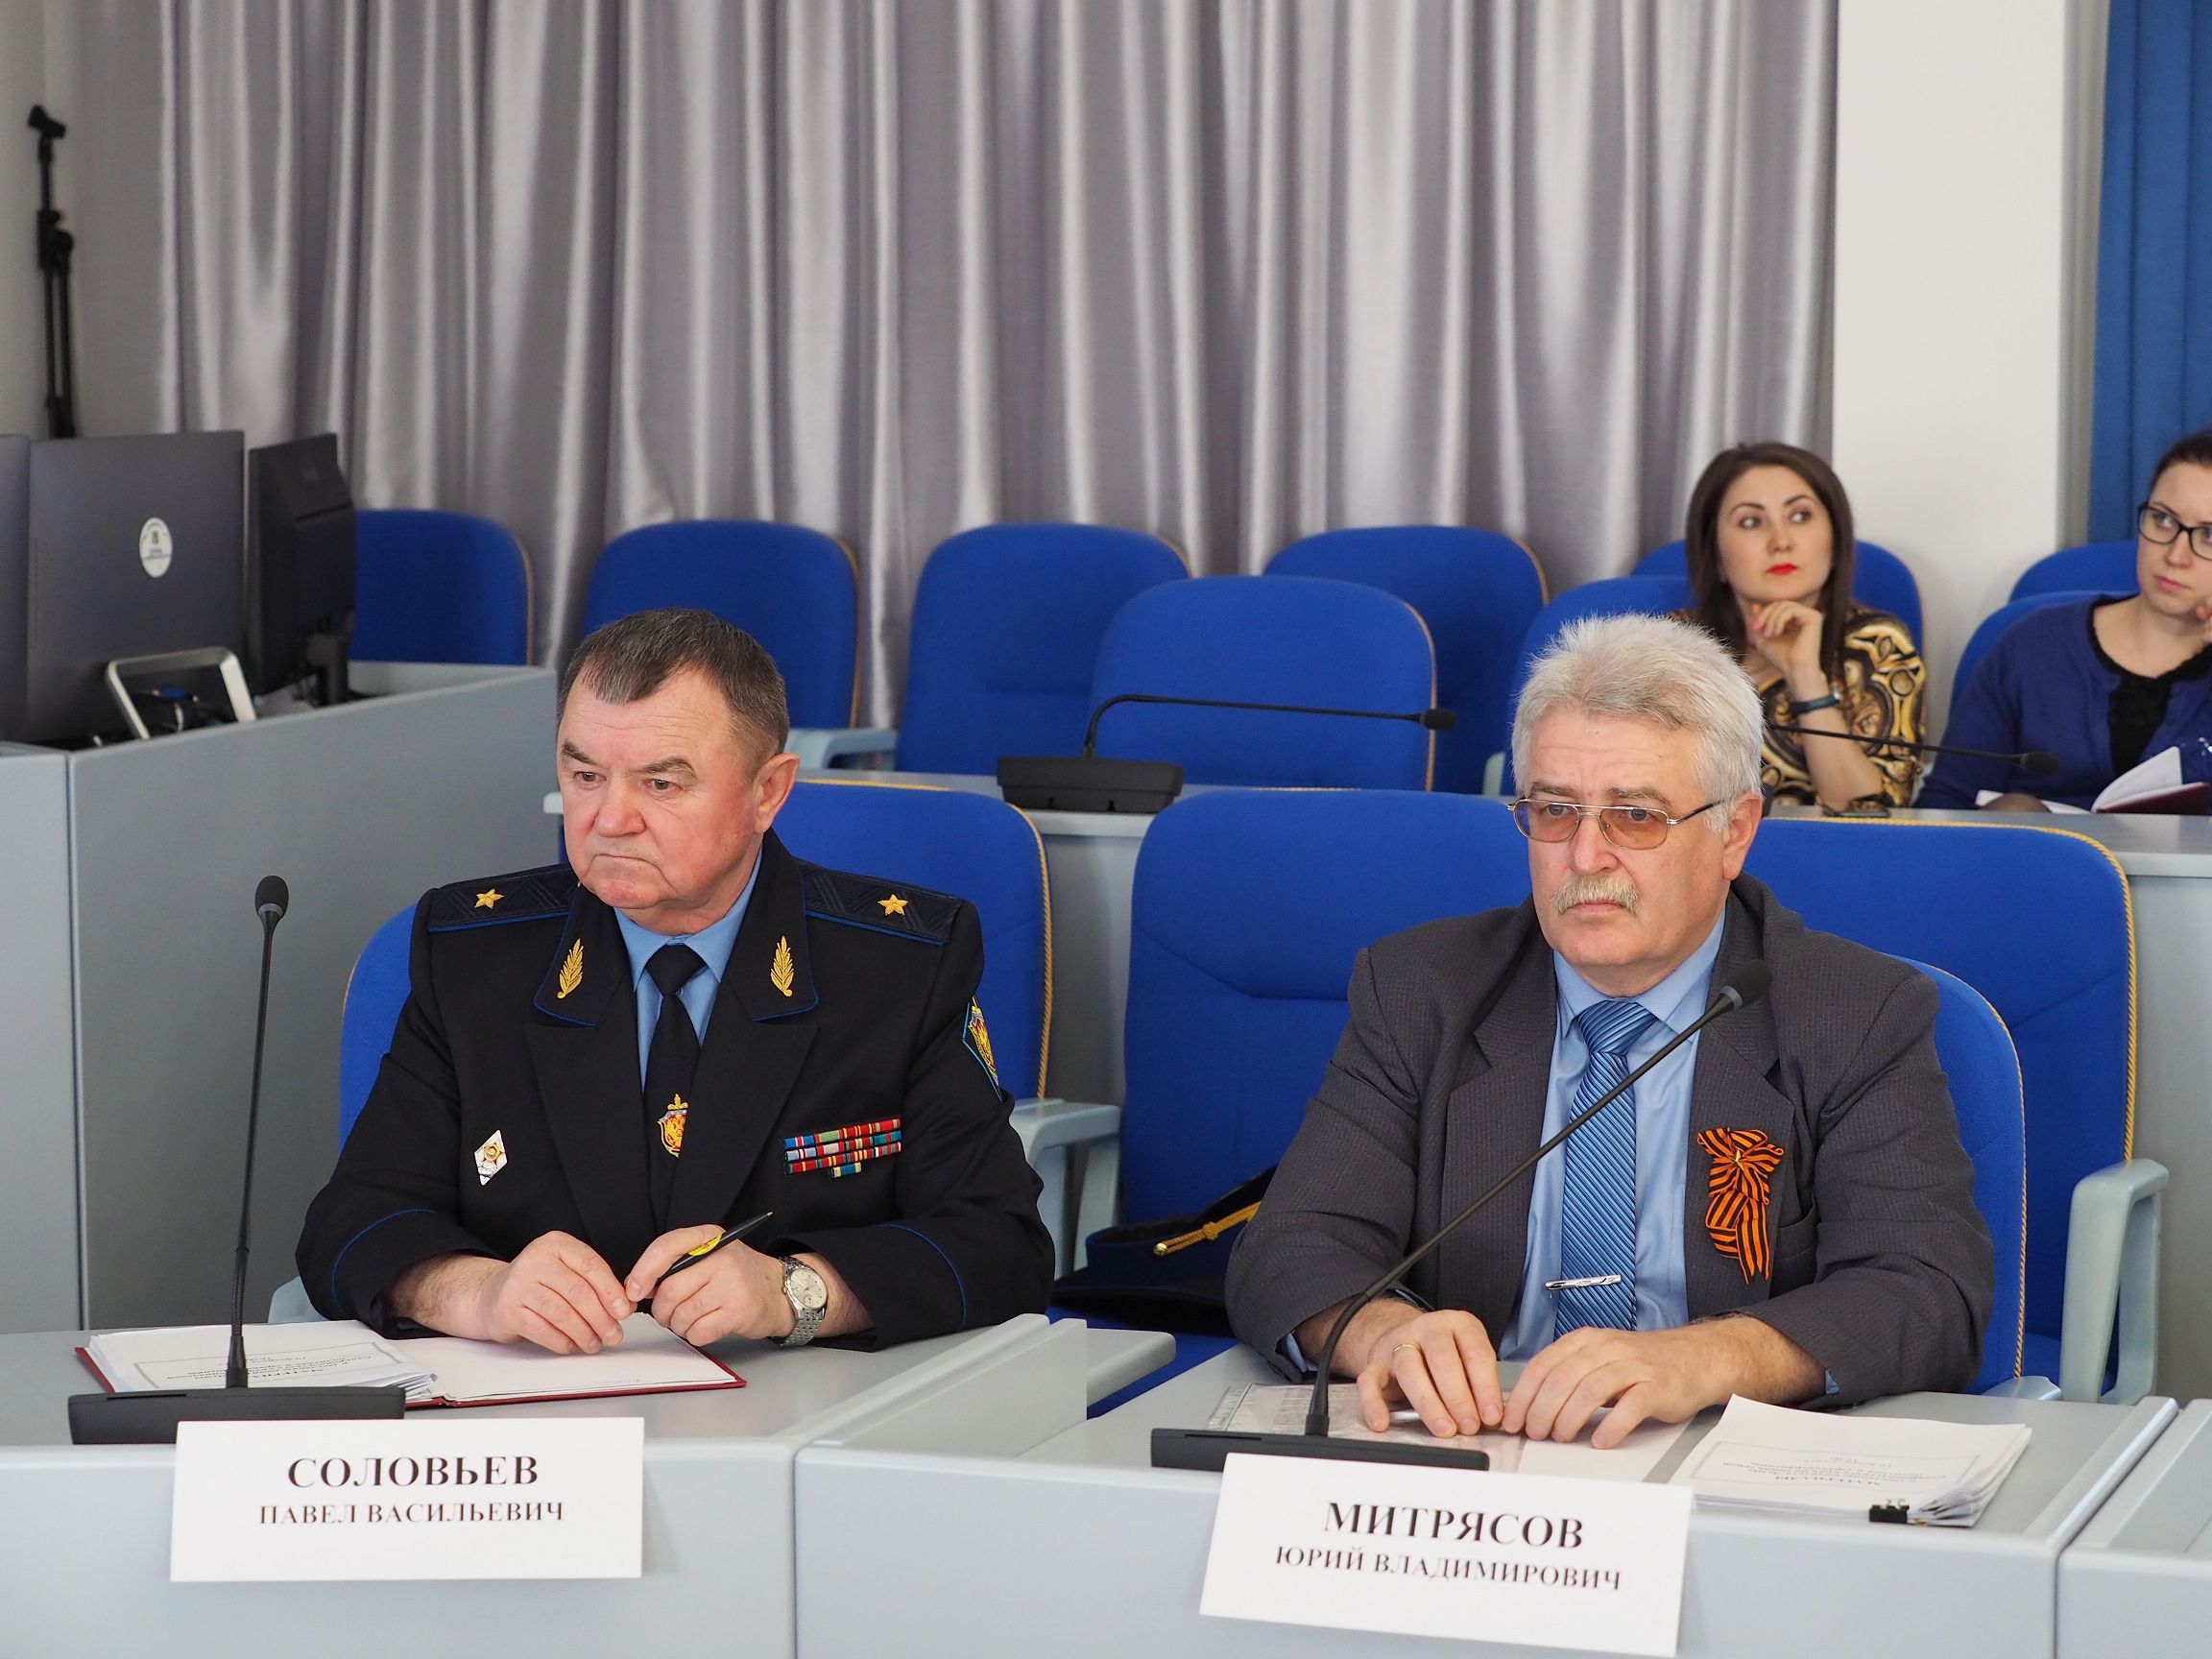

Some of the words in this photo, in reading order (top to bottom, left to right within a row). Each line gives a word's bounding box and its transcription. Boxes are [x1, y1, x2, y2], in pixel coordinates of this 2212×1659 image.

[287, 1456, 539, 1488] СОЛОВЬЕВ
[260, 1504, 356, 1525] ПАВЕЛ
[368, 1502, 563, 1524] ВАСИЛЬЕВИЧ
[1325, 1503, 1582, 1549] МИТРЯСОВ
[1276, 1547, 1363, 1571] ЮРИЙ
[1375, 1553, 1620, 1590] ВЛАДИМИРОВИЧ
